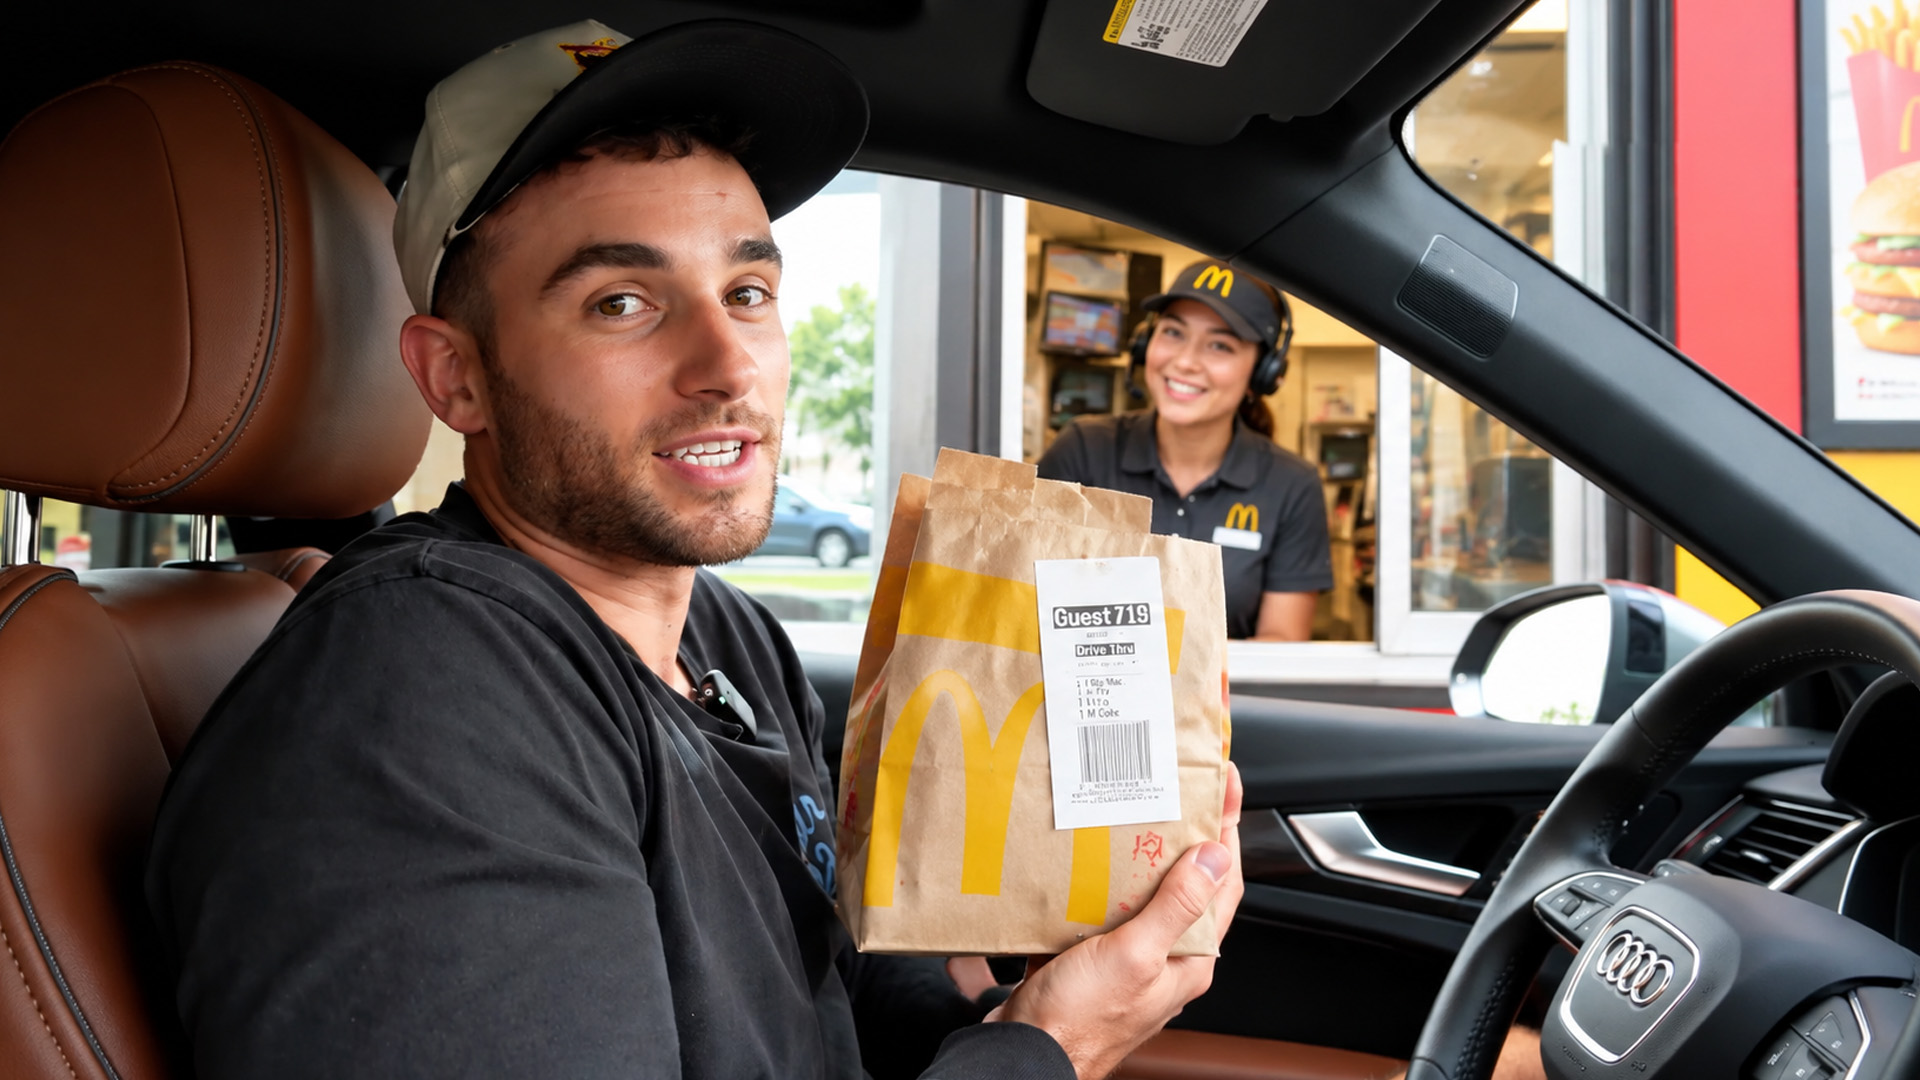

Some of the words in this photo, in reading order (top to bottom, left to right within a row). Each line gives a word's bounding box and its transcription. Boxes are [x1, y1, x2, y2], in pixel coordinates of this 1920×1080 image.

[1053, 606, 1112, 628] Guest
[1113, 603, 1150, 625] 719
[1076, 644, 1107, 657] Drive
